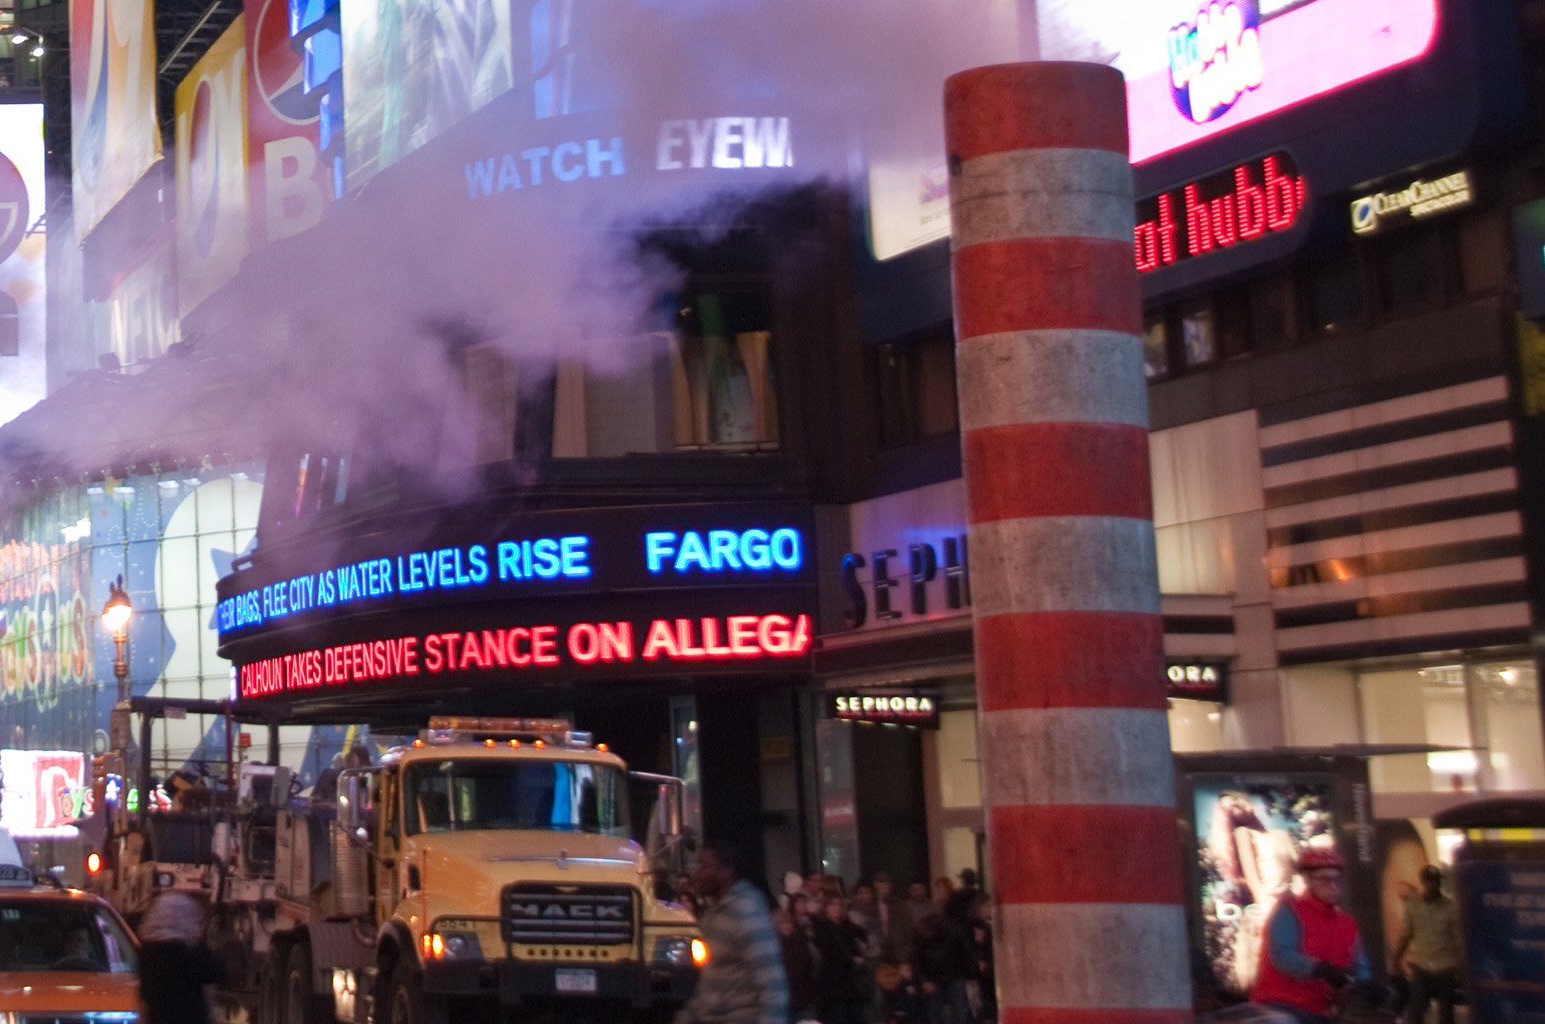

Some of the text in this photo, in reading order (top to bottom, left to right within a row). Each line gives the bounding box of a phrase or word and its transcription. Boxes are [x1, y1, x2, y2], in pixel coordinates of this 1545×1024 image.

[464, 136, 625, 200] WATCH
[1185, 156, 1306, 256] hubb
[236, 589, 263, 626] BAGS,
[263, 580, 288, 618] FLEE
[289, 574, 316, 612] CITY
[317, 570, 336, 606] AS
[336, 558, 393, 602] WATER
[396, 544, 488, 591] LEVELS
[497, 536, 590, 579] RISE
[645, 528, 800, 571] FARGO
[841, 533, 972, 629] SEPH
[241, 655, 284, 698] CALHOUN
[284, 649, 322, 689] TAKES
[324, 636, 419, 683] DEFENSIVE
[424, 624, 560, 671] STANCE
[567, 621, 634, 662] ON
[1168, 665, 1217, 682] ORA
[835, 696, 935, 713] SEPHORA
[510, 903, 623, 918] MACK
